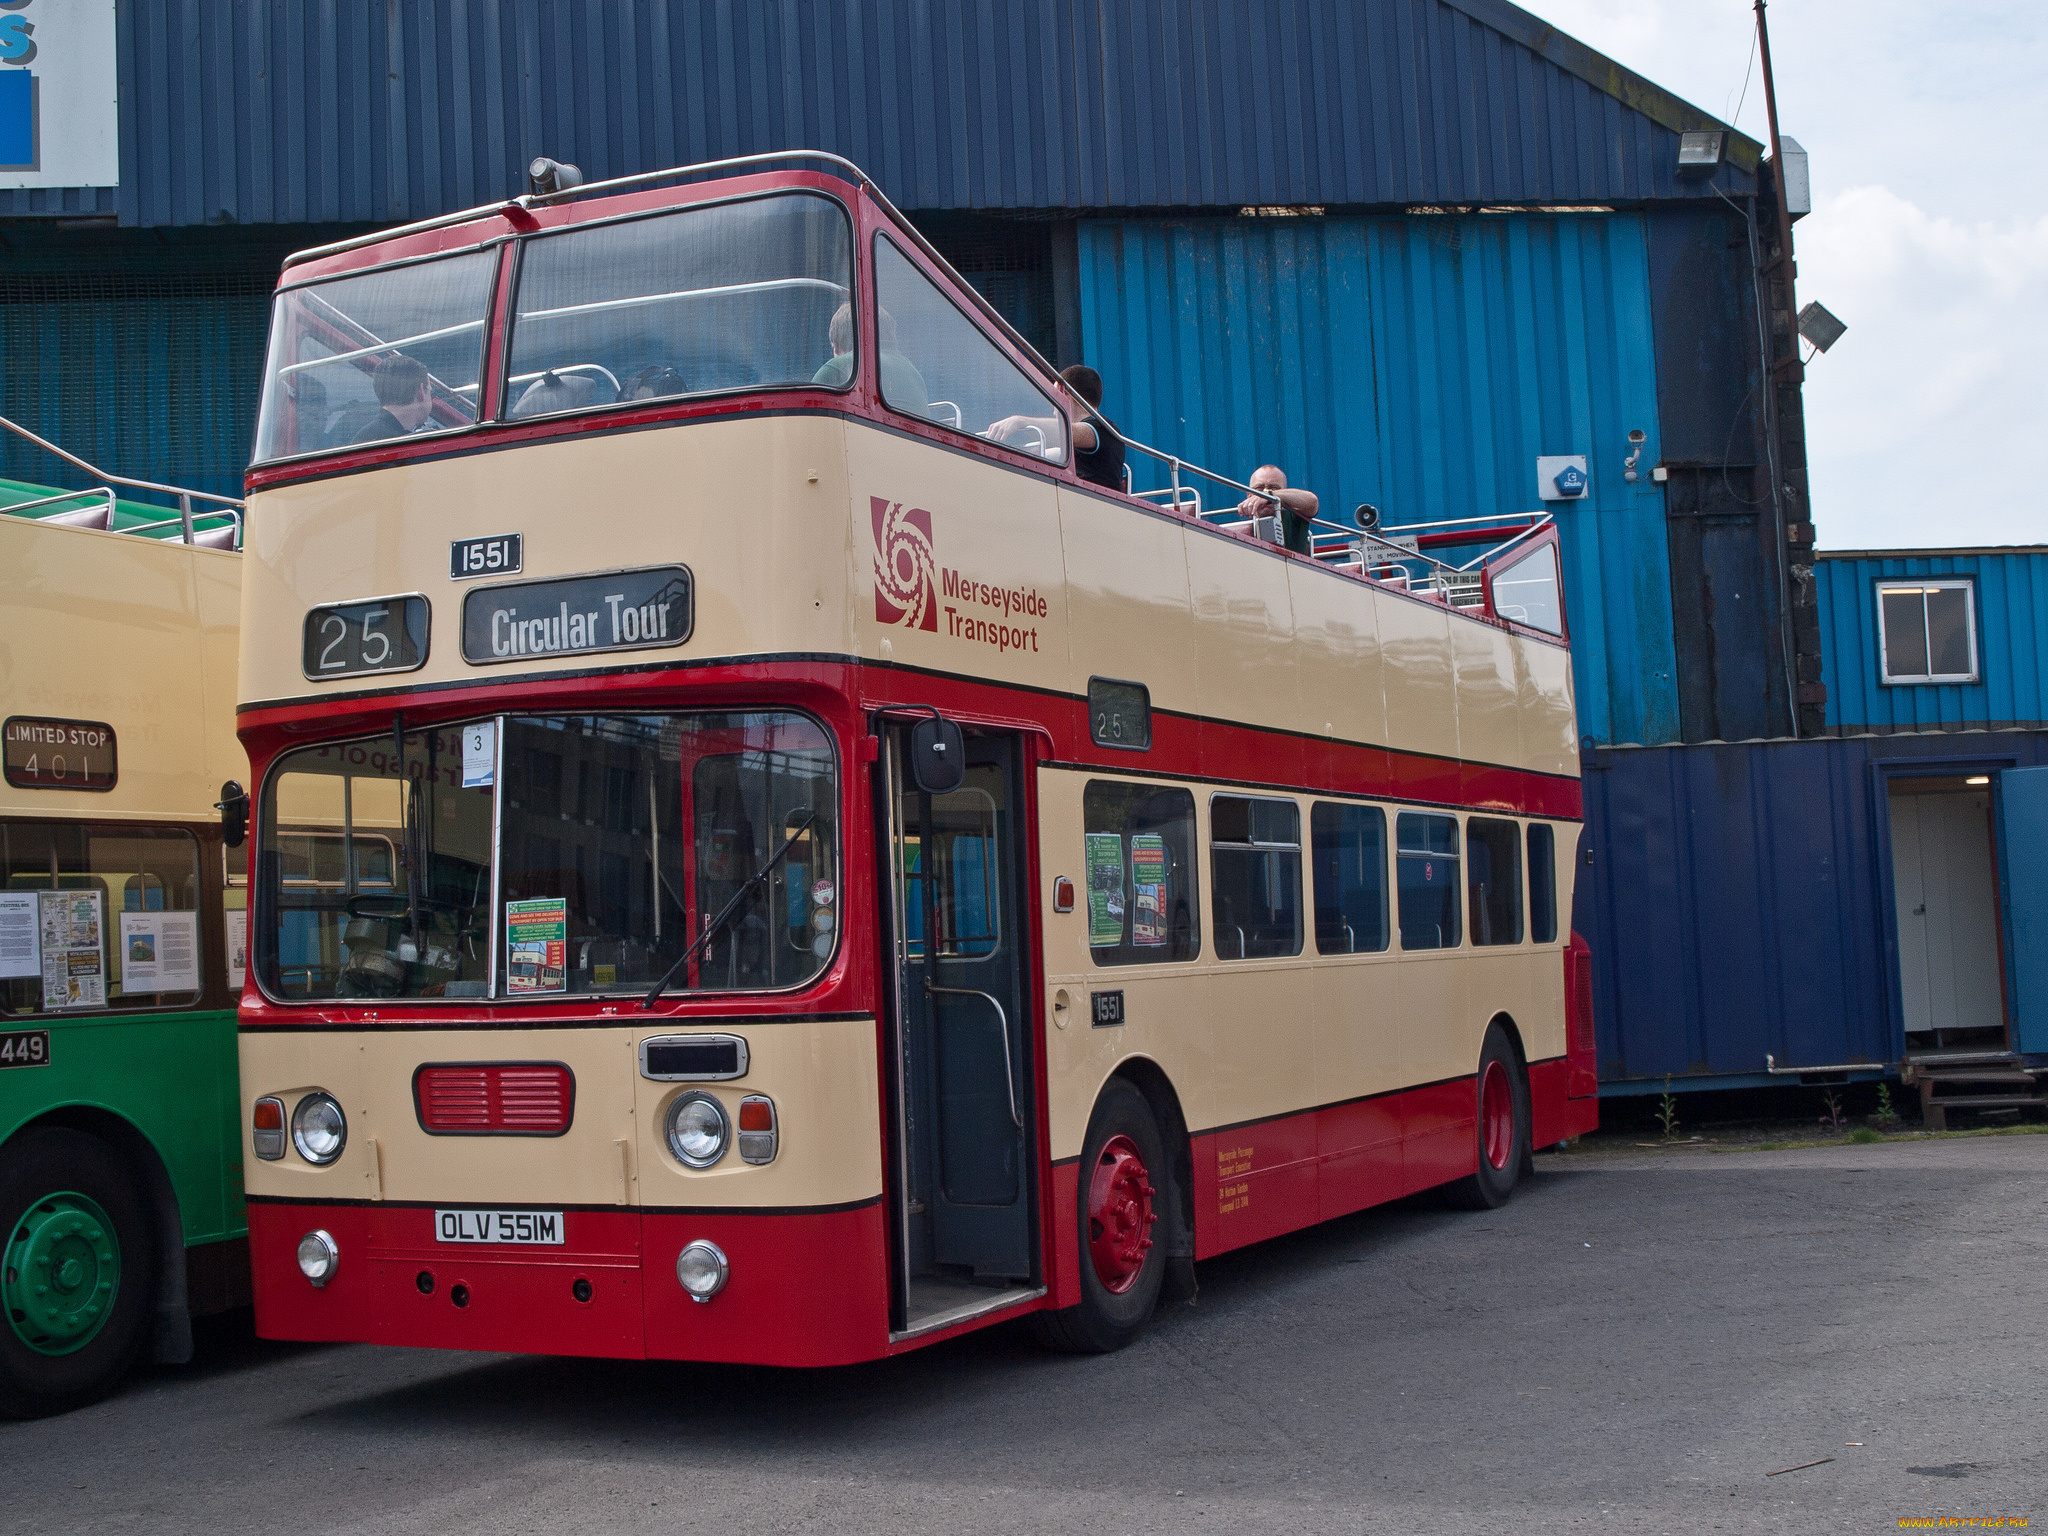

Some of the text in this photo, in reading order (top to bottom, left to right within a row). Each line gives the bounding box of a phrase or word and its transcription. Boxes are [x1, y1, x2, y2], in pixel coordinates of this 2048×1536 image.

[463, 541, 508, 572] 1551
[942, 567, 1048, 618] Merseyside
[492, 594, 670, 656] Circular Tour
[945, 606, 1038, 652] Transport
[6, 725, 106, 747] LIMITED STOP
[1098, 712, 1122, 738] 25
[474, 734, 482, 752] 3
[1098, 996, 1120, 1020] 1551
[0, 1036, 44, 1062] 449
[442, 1213, 556, 1241] OLV 551M
